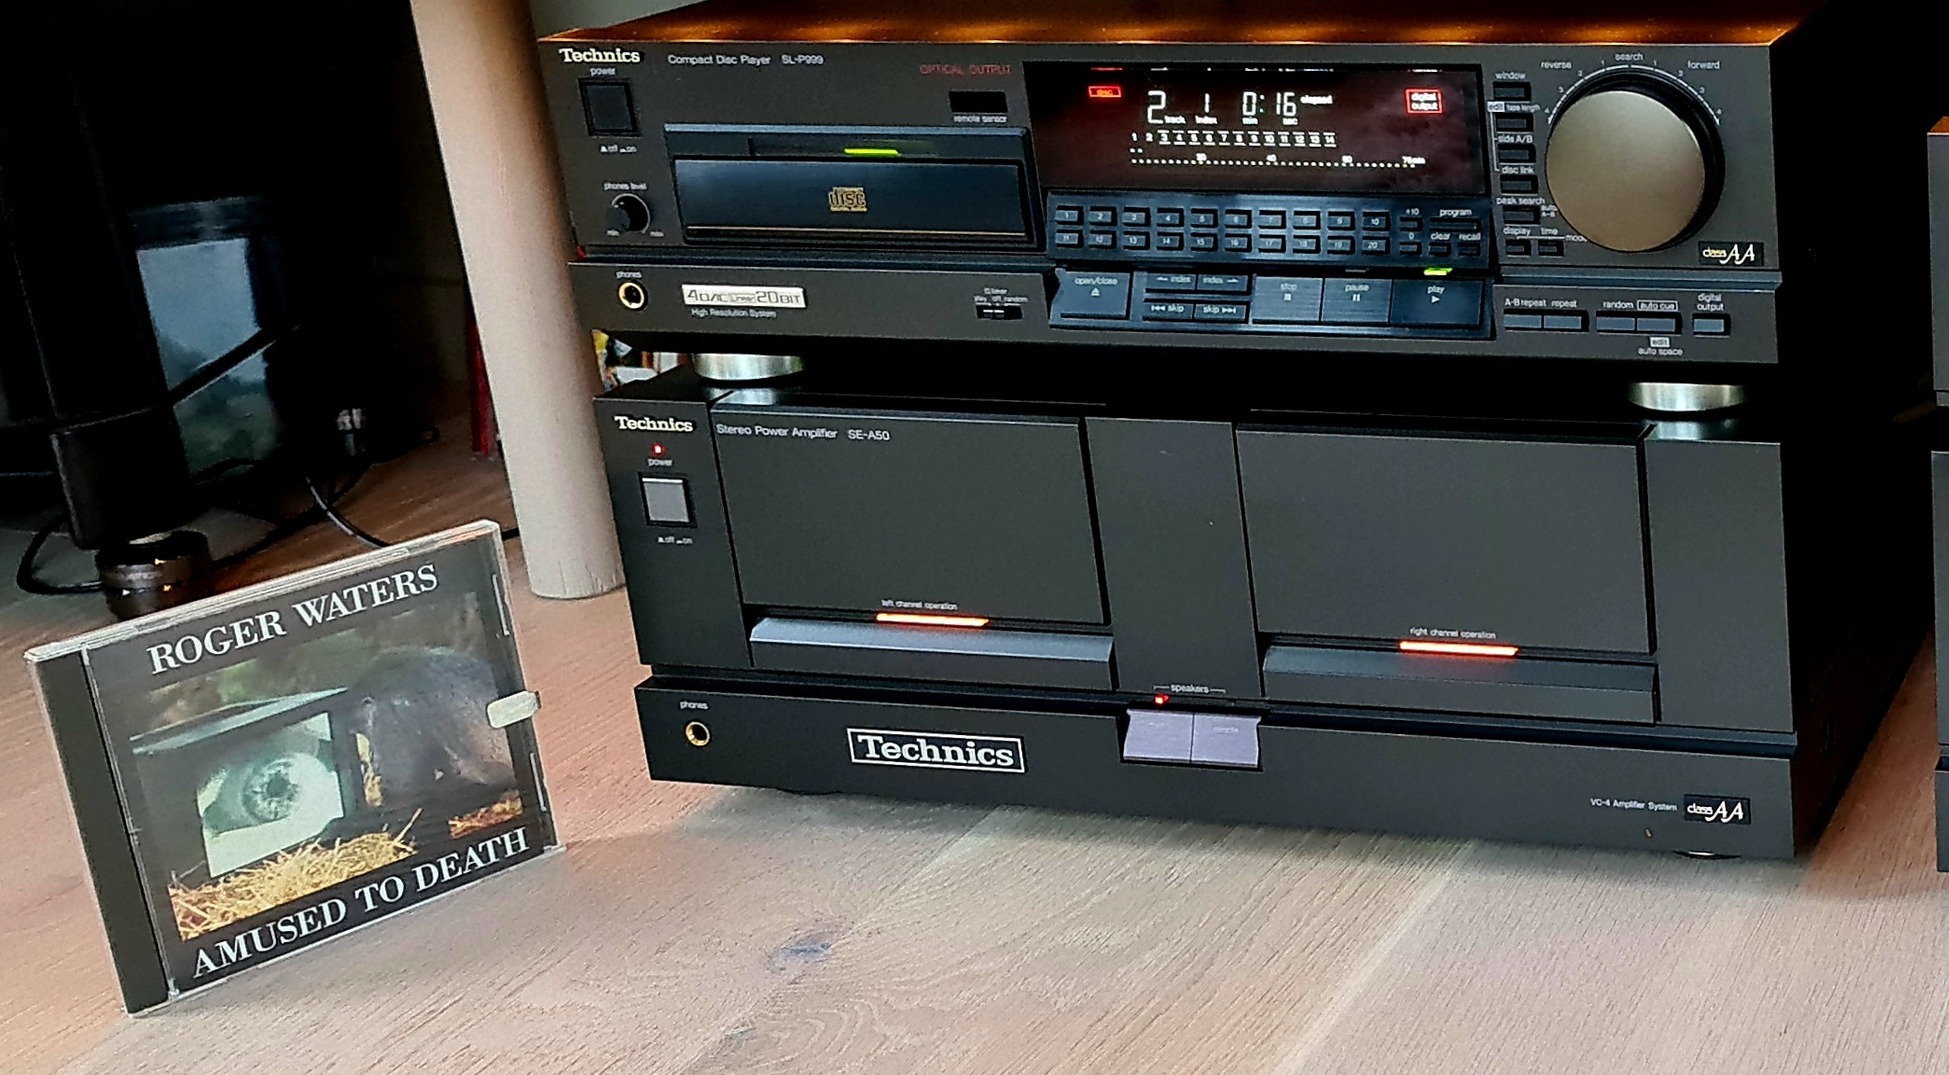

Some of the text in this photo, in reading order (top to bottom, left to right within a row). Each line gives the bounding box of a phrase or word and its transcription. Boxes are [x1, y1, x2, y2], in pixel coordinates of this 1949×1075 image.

[558, 47, 641, 63] Technics
[781, 55, 824, 65] SL-P999
[1615, 53, 1643, 61] search
[668, 55, 771, 66] Compact Disc Player
[1541, 61, 1572, 69] reverse
[1688, 61, 1720, 70] forward
[590, 68, 615, 77] power
[920, 64, 1012, 75] OPTICAL OUTPUT
[1495, 71, 1526, 80] window
[1411, 92, 1436, 102] digital
[1147, 90, 1166, 124] 2
[1204, 93, 1210, 113] 1
[1242, 91, 1297, 117] 0:16
[1411, 102, 1438, 111] output
[1506, 104, 1520, 112] tape
[1521, 103, 1541, 113] length
[954, 115, 980, 123] remote
[1195, 115, 1218, 125] index
[1131, 132, 1335, 144] 1 2 3 4 5 6 7 8 9 10 11 12 13 14
[1498, 135, 1534, 143] side A/B
[1502, 166, 1535, 174] disc link
[604, 183, 629, 191] phones
[1496, 197, 1545, 205] peak search
[1439, 209, 1472, 217] program
[1430, 232, 1451, 241] clear
[1459, 232, 1481, 241] recall
[1503, 227, 1558, 236] display time
[616, 271, 642, 279] phones
[1170, 275, 1191, 283] index
[1203, 276, 1224, 284] index
[1074, 276, 1118, 286] open/close
[1280, 283, 1297, 292] stop
[1345, 283, 1369, 293] pause
[1427, 285, 1445, 295] play
[1698, 292, 1722, 303] digital
[1505, 298, 1547, 309] A-B repeat
[1551, 299, 1577, 309] repeat
[1603, 300, 1634, 309] random
[1640, 302, 1675, 310] auto cue
[1697, 302, 1724, 312] output
[691, 308, 777, 318] High Resolution System
[1168, 304, 1185, 314] skip
[1203, 305, 1220, 315] skip
[1652, 338, 1668, 346] edit
[1638, 347, 1683, 357] auto space
[614, 415, 693, 432] Technics
[716, 424, 837, 440] Stereo Power Amplifier
[848, 429, 890, 441] SE-A50
[648, 458, 673, 467] power
[881, 599, 958, 611] left channel operation
[147, 563, 439, 675] ROGER WATERS
[1409, 627, 1497, 639] right channel operation
[1170, 684, 1209, 694] speakers
[680, 700, 708, 710] phones
[858, 733, 1014, 767] Technics
[1612, 799, 1645, 810] Amplifier
[1648, 801, 1678, 812] System
[1686, 803, 1713, 815] class
[193, 827, 531, 979] AMUSED TO DEATH
